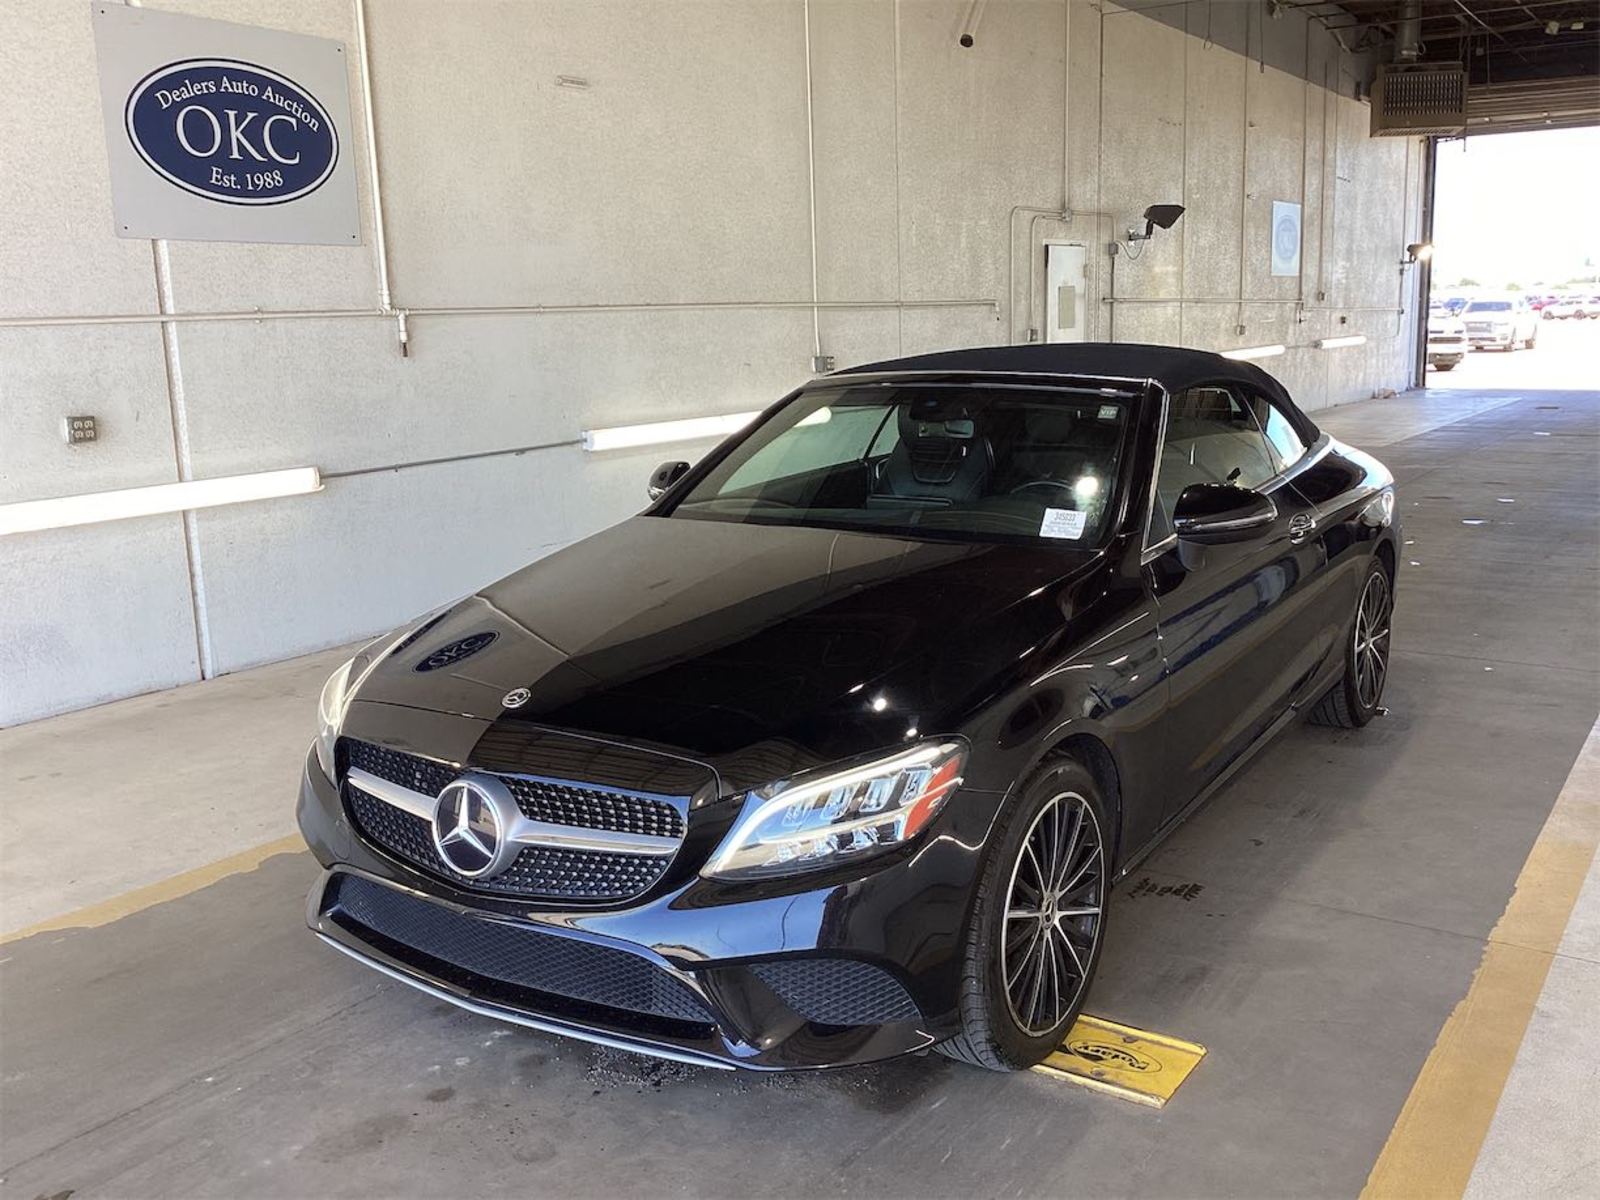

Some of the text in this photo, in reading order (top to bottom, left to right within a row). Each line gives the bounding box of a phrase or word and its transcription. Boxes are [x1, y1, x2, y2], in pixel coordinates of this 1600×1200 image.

[154, 76, 320, 133] Dealers Auto Auction
[175, 105, 300, 165] OKC
[209, 166, 283, 191] Est. 1988
[1078, 1042, 1150, 1070] Rotary
